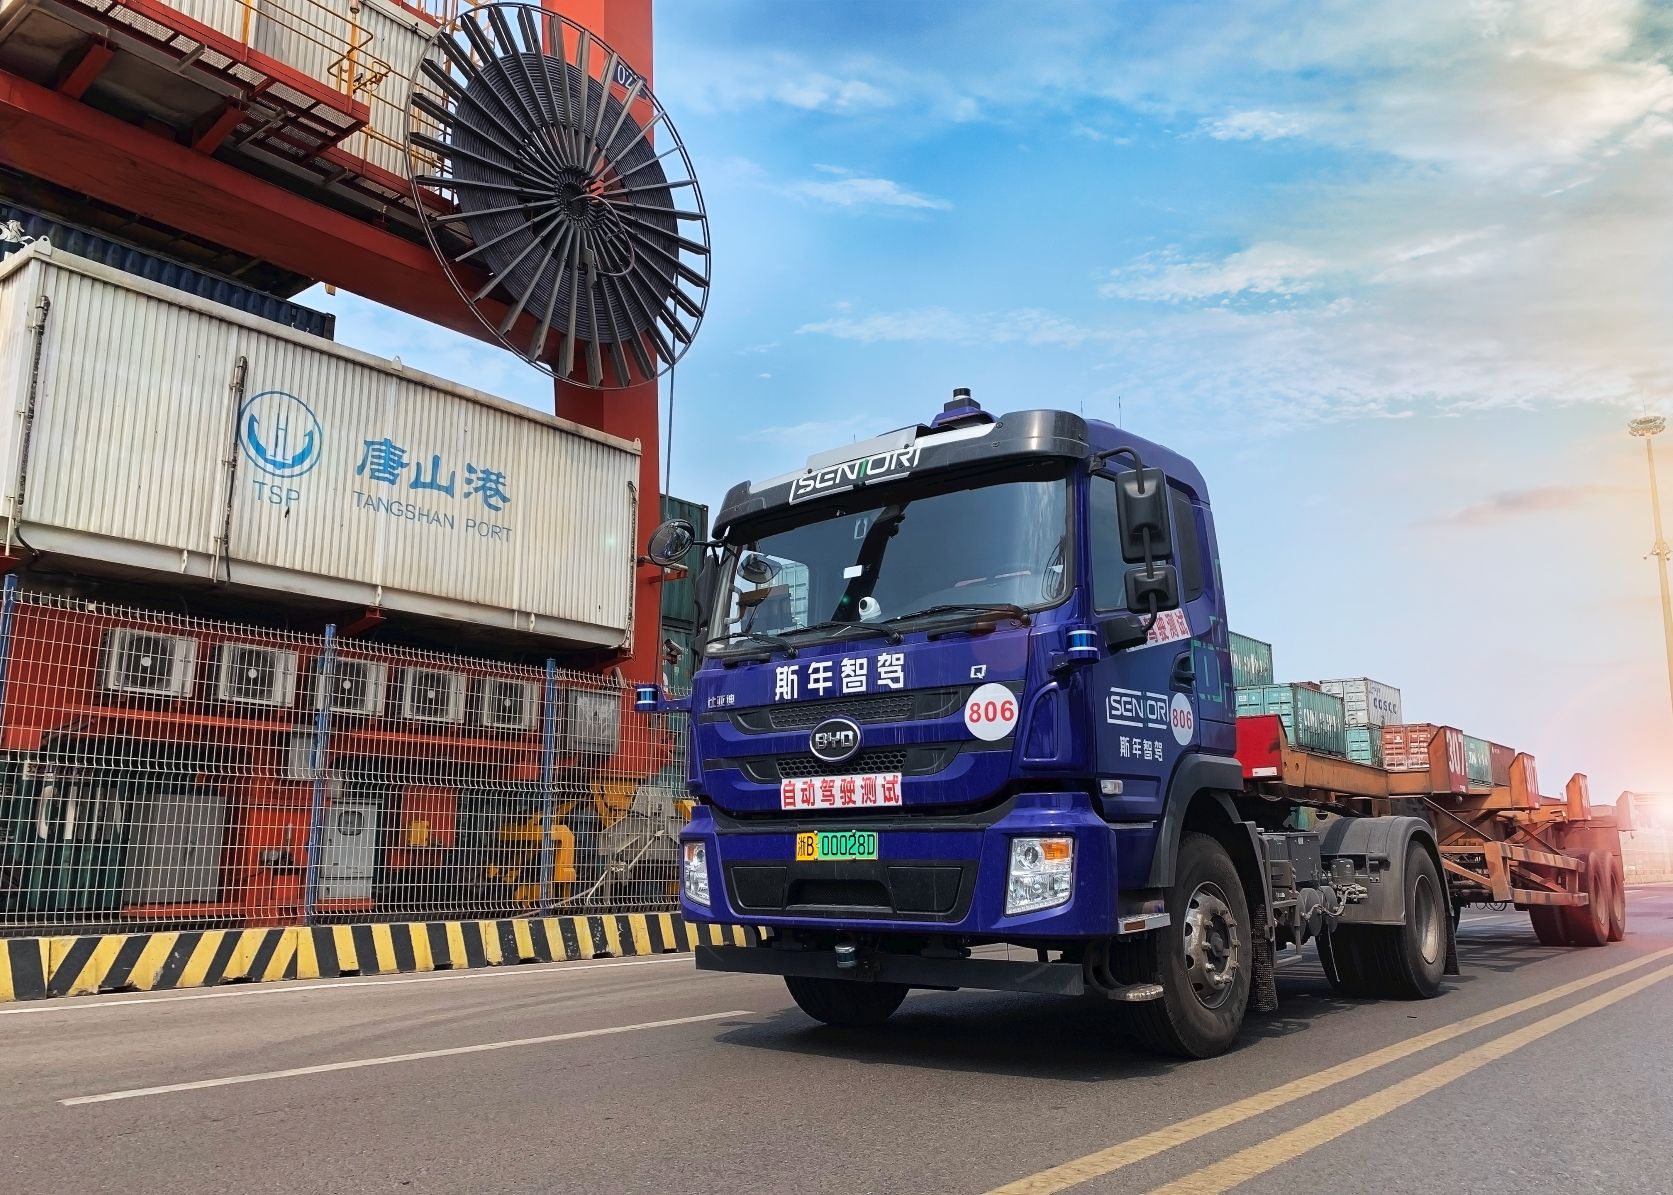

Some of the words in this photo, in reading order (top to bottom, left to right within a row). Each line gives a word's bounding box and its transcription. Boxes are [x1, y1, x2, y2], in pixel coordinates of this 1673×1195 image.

[356, 438, 511, 512] 唐山港
[796, 447, 914, 495] SENIOR
[252, 480, 300, 507] TSP
[353, 491, 455, 530] TANGSHAN
[465, 518, 513, 543] PORT
[775, 653, 905, 701] 斯年智驾
[969, 700, 1015, 723] 806
[1110, 695, 1168, 722] SENIOR
[1172, 708, 1193, 730] 806
[815, 730, 854, 750] BYD
[1119, 736, 1164, 762] 斯年智驾
[1446, 730, 1465, 776] 307
[782, 775, 900, 808] 自动驾驶测试
